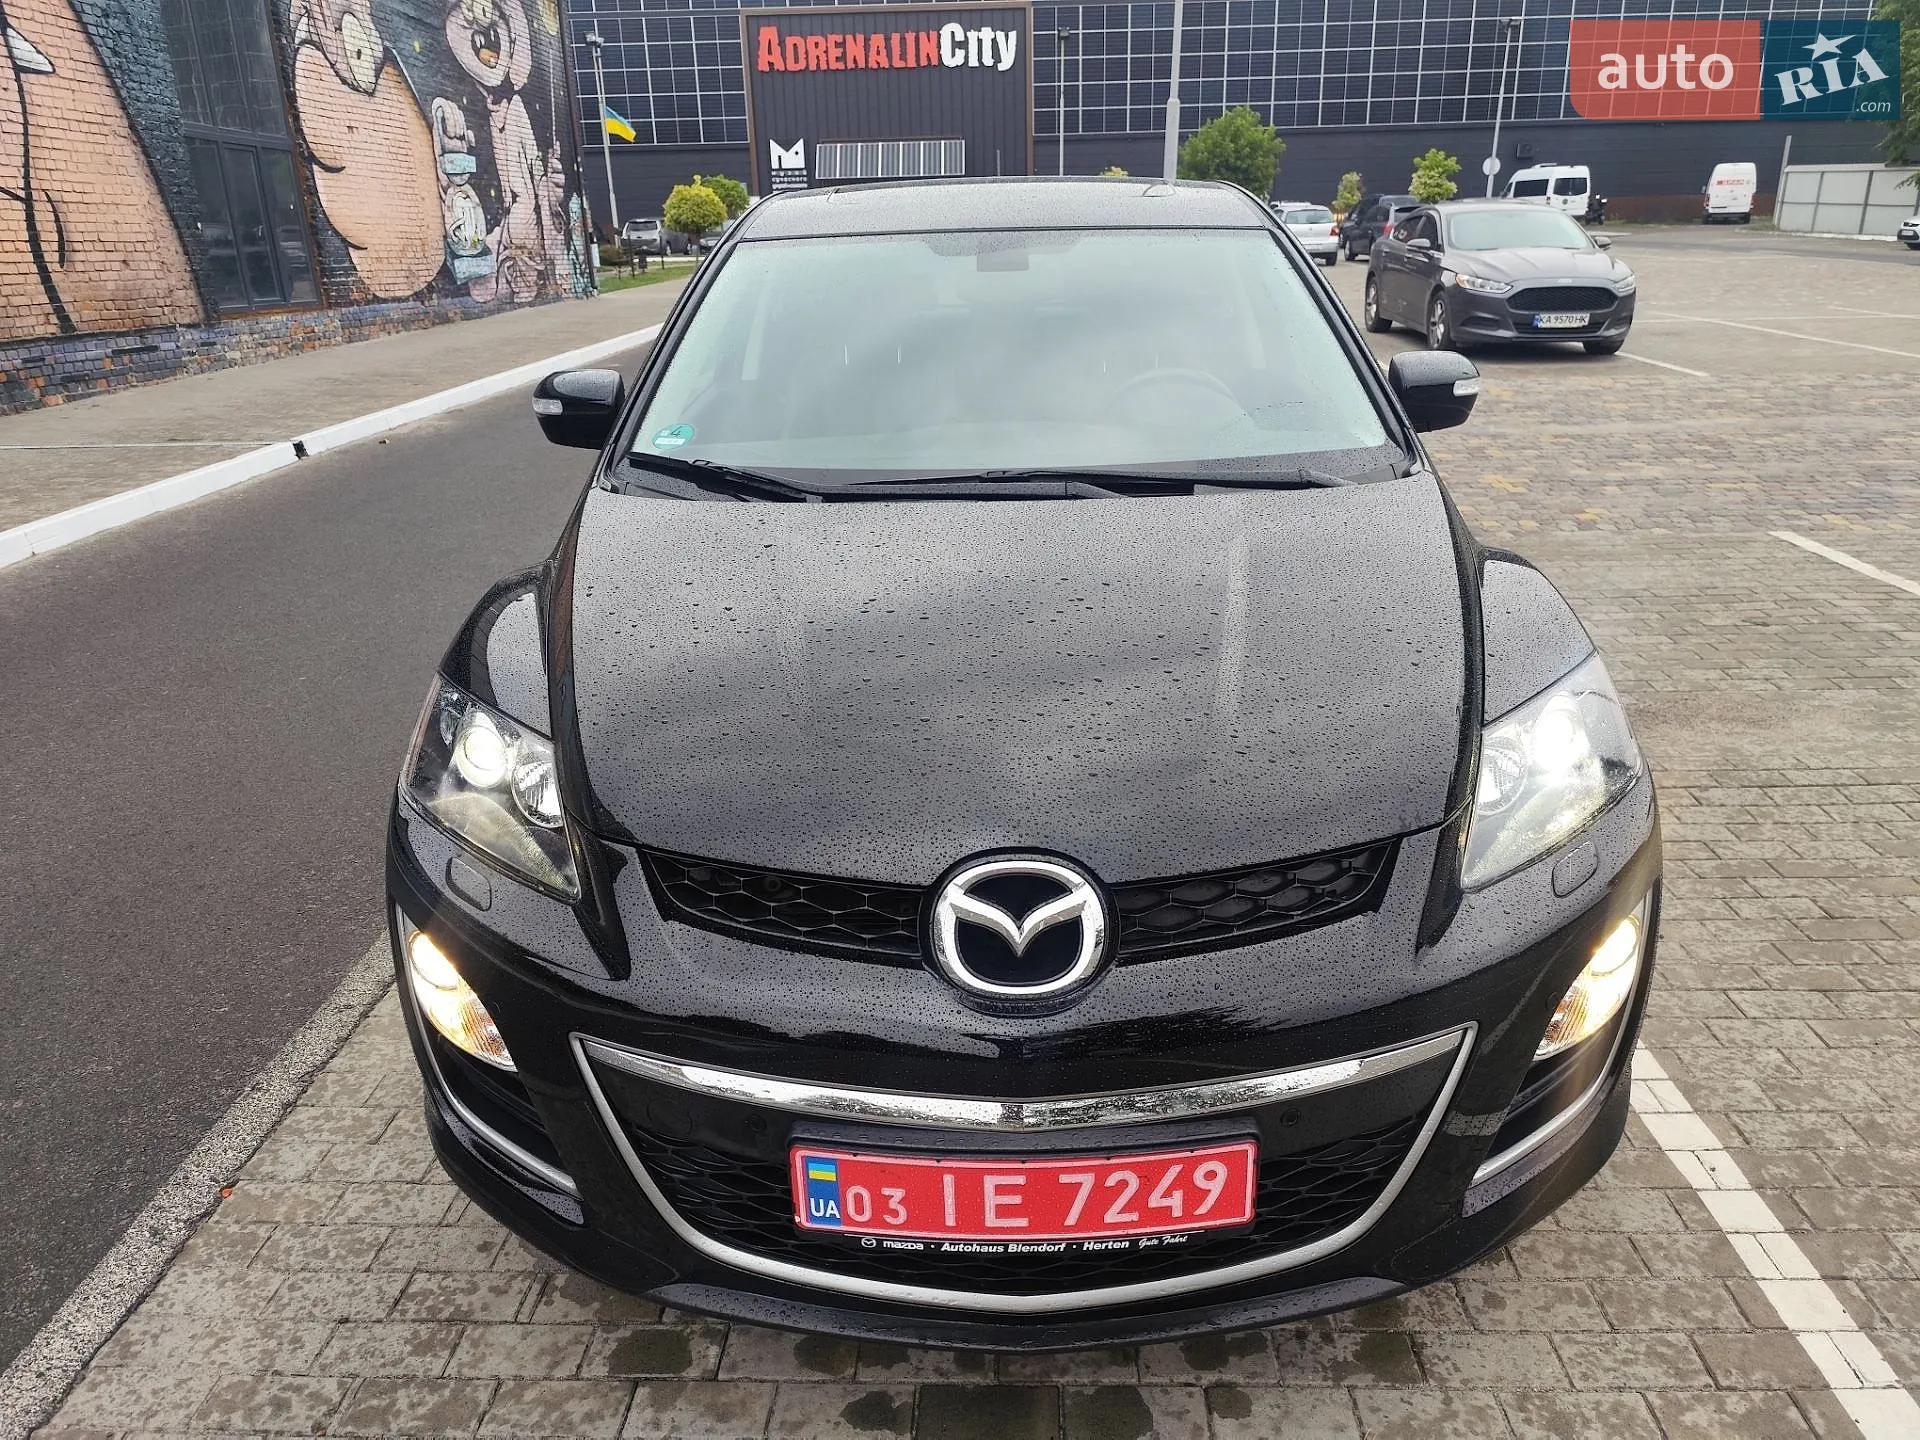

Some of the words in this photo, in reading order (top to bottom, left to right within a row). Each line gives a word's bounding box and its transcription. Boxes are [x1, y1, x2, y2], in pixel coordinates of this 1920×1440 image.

[846, 1185, 908, 1225] 03
[943, 1174, 1030, 1229] IE
[1058, 1161, 1228, 1228] 7249
[810, 1198, 841, 1219] UA
[941, 1242, 1005, 1253] Autohaus
[1007, 1242, 1067, 1253] Blendorf
[1082, 1240, 1130, 1251] Herten
